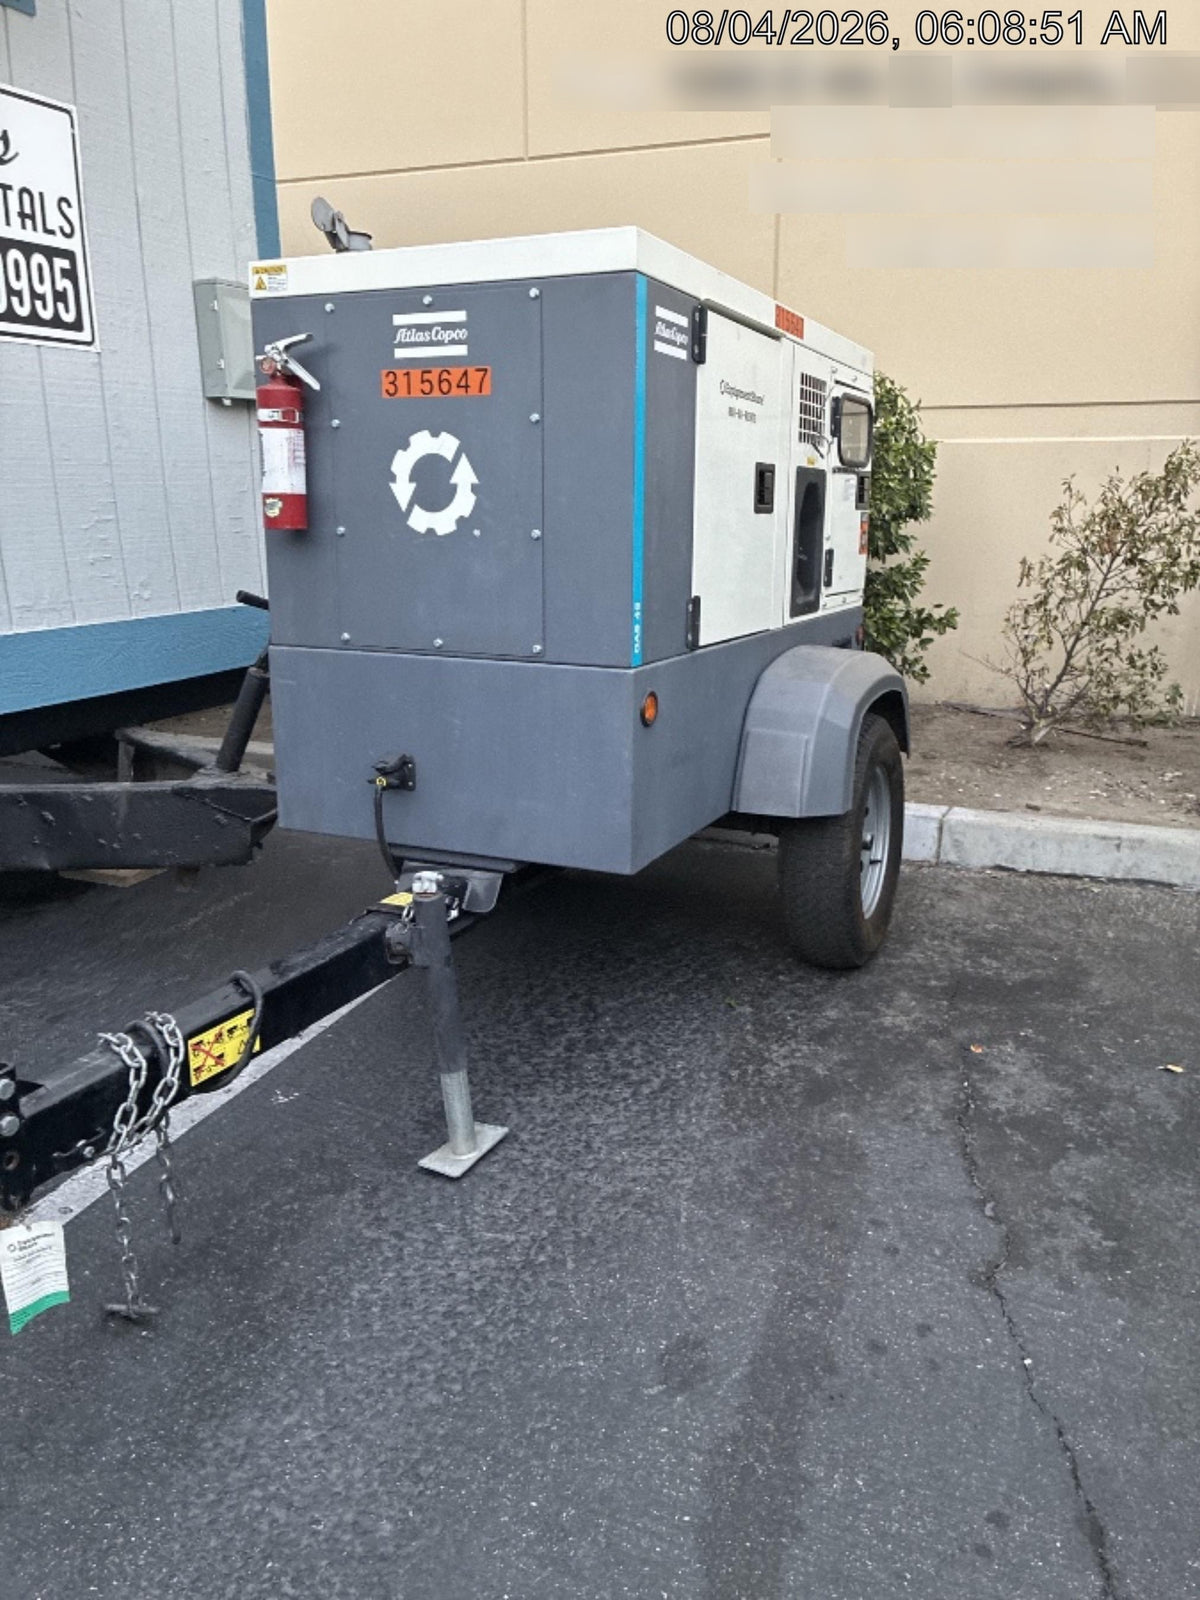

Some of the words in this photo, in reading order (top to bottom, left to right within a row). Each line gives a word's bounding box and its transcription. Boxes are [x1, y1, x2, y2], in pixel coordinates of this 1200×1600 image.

[0, 248, 77, 323] 995
[394, 328, 430, 344] Atlas
[431, 326, 468, 343] Copco
[384, 367, 489, 397] 315647
